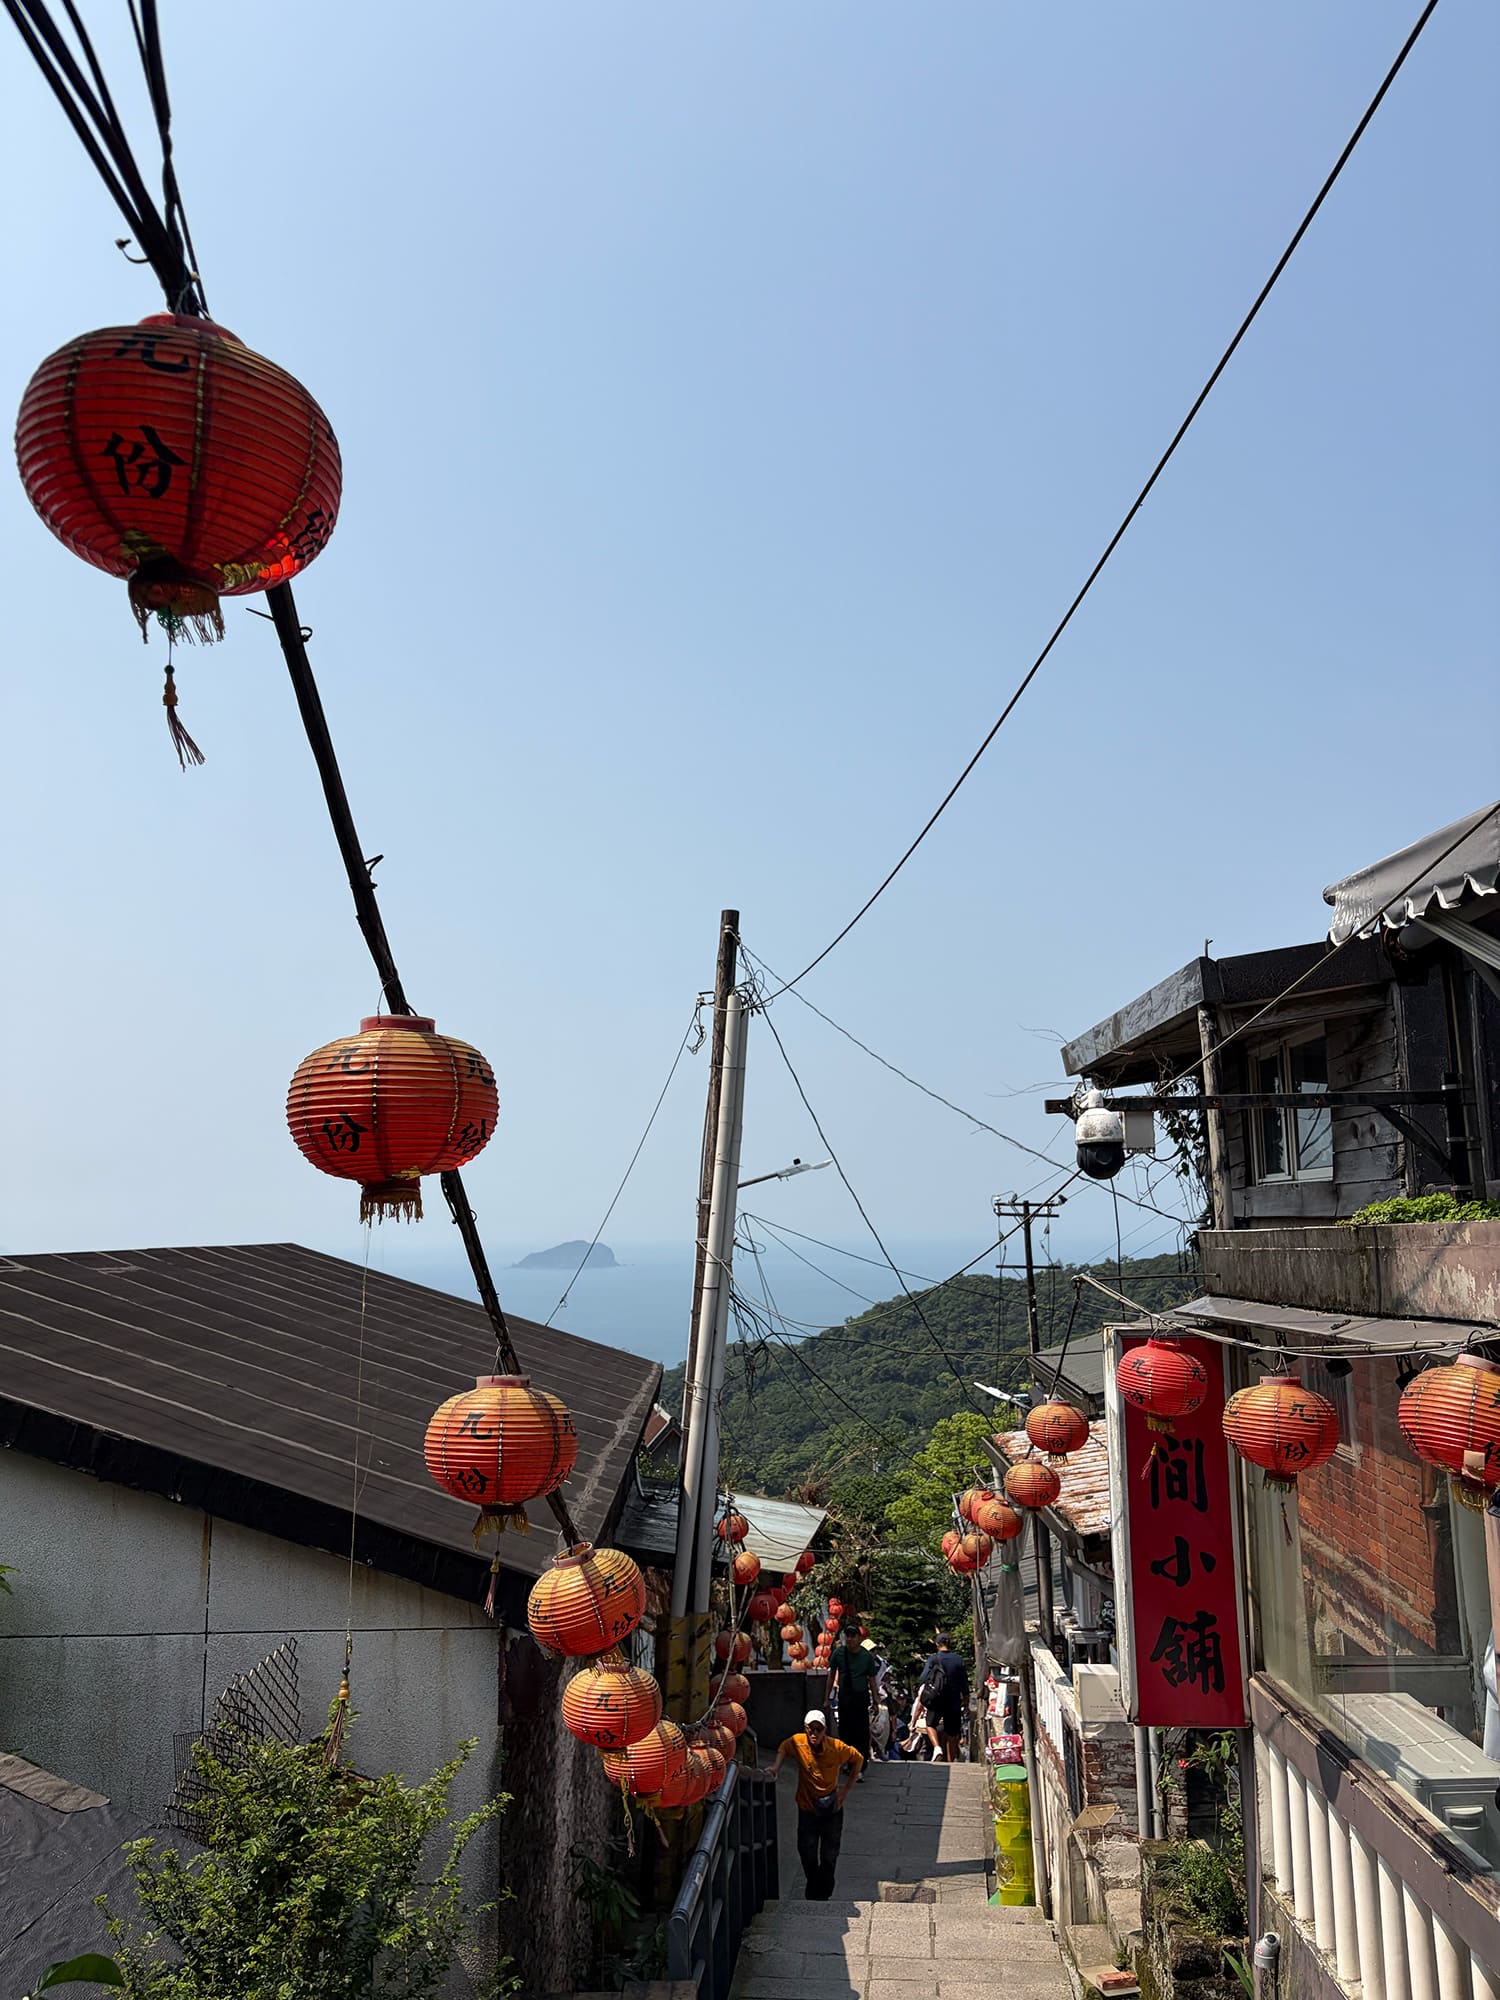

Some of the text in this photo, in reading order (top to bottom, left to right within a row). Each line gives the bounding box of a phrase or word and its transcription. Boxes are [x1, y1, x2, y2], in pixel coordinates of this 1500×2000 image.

[103, 332, 190, 498] 九份
[322, 1045, 371, 1153] 九份
[456, 1411, 493, 1495] 九份
[1283, 1403, 1314, 1461] 九份
[602, 1573, 634, 1638] 九份
[594, 1693, 619, 1745] 九份
